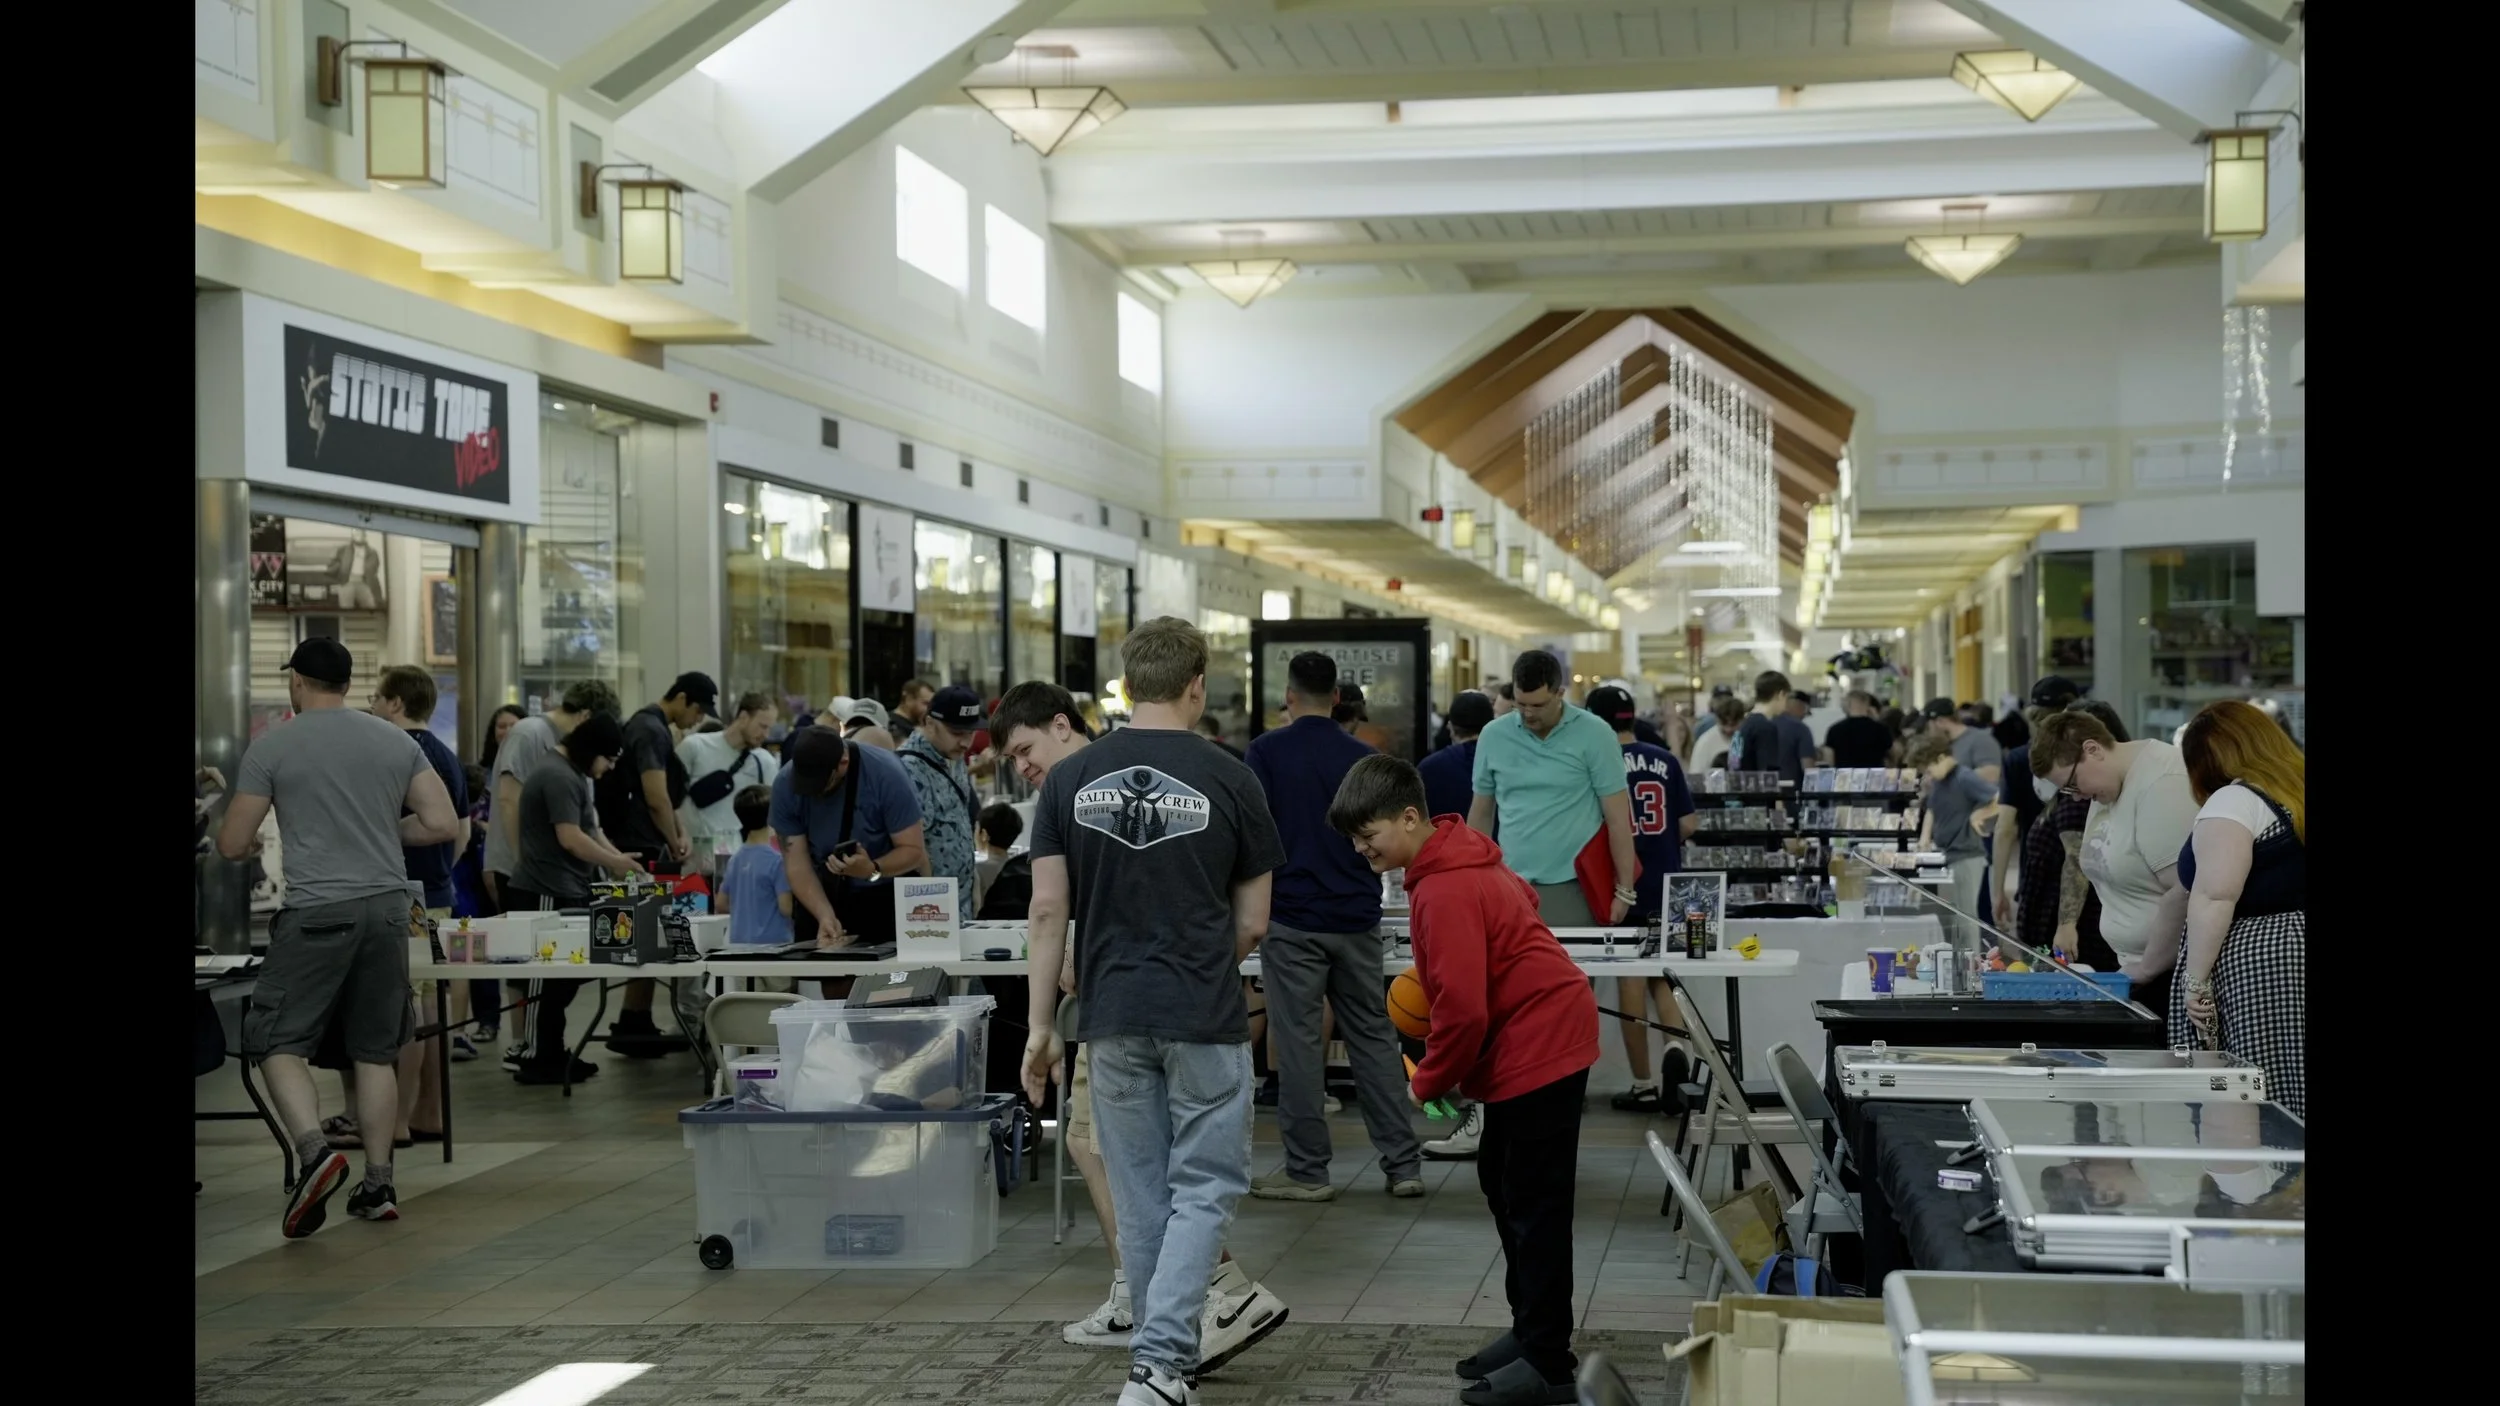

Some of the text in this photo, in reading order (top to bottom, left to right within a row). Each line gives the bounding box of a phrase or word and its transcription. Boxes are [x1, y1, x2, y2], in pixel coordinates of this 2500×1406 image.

[329, 352, 491, 443] STATIC TAPE
[454, 426, 500, 490] VIDEO
[1624, 752, 1647, 772] ÑA
[1078, 791, 1205, 811] SALTY CREW
[1080, 806, 1194, 822] CHASING TAIL
[904, 882, 949, 897] BUYING
[1133, 1365, 1146, 1377] NIKE
